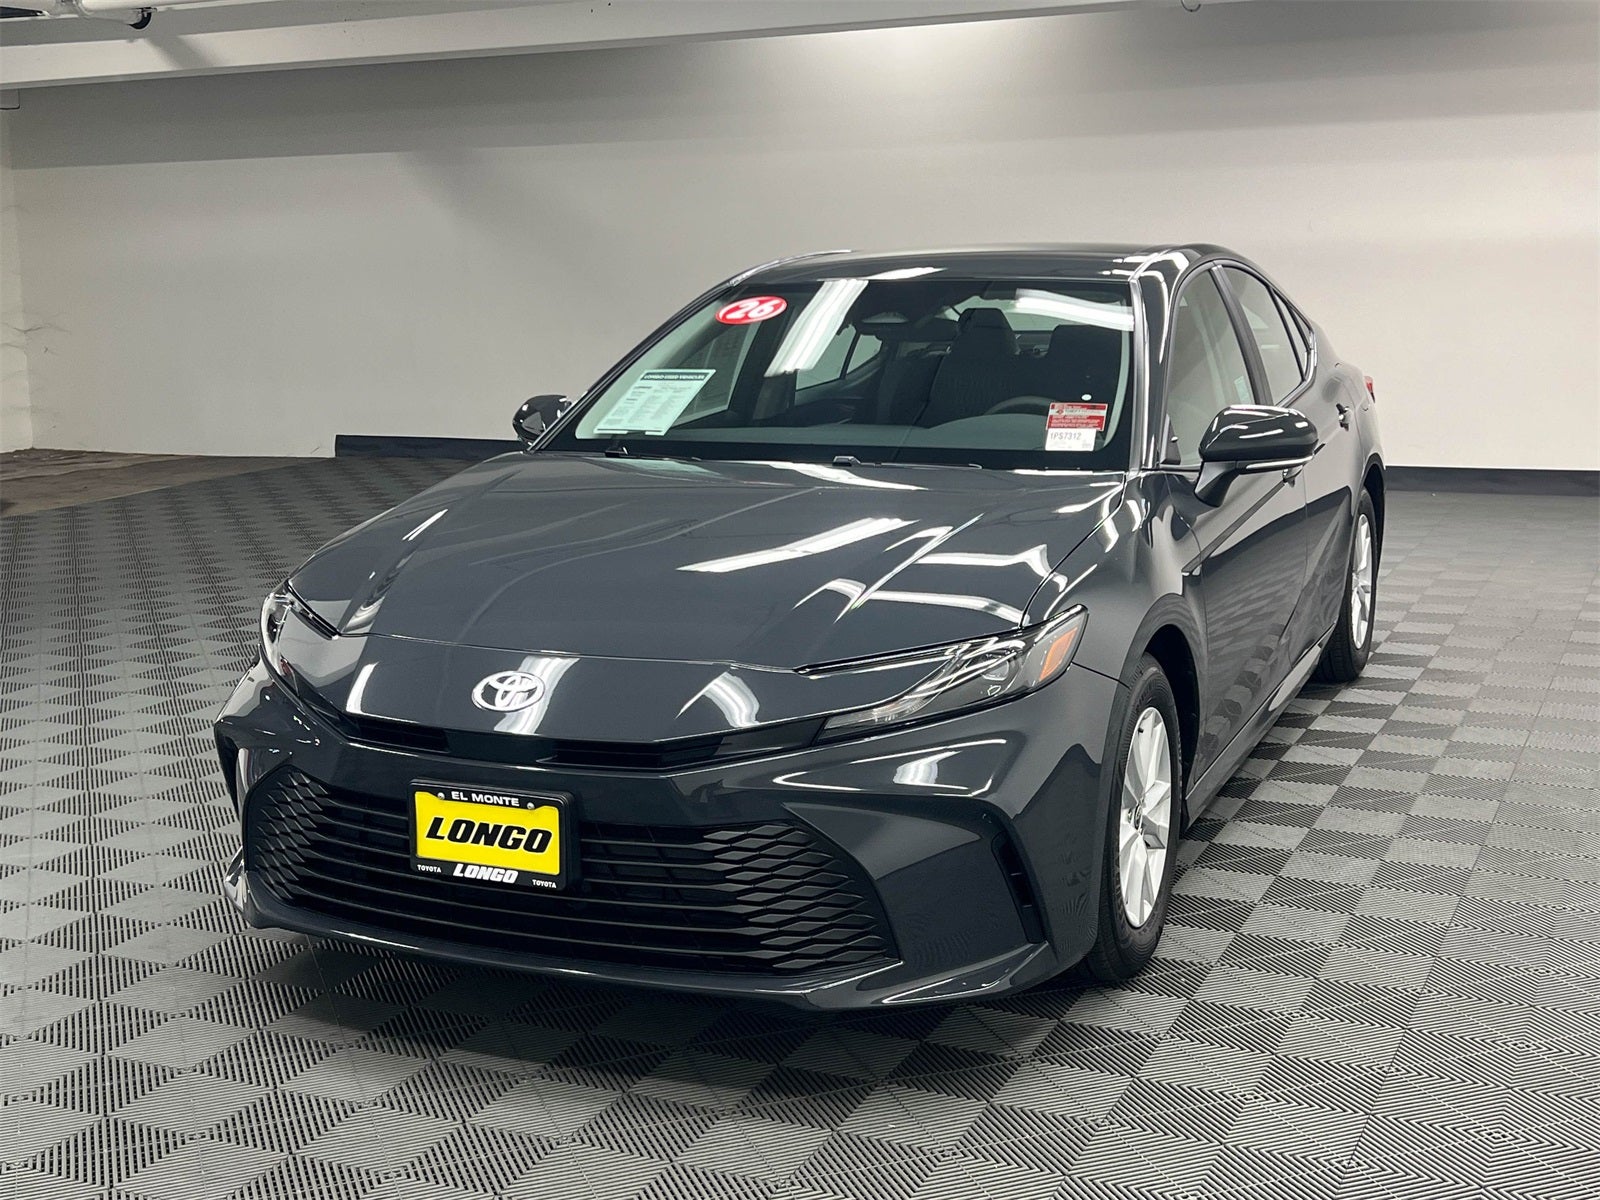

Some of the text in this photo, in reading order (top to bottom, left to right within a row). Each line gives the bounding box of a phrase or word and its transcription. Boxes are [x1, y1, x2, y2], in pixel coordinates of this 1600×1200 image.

[725, 299, 780, 319] 26
[451, 791, 520, 807] EL MONTE
[426, 817, 553, 853] LONGO
[417, 864, 442, 873] TOYOTA
[453, 863, 519, 884] LONGO
[532, 879, 557, 889] TOYOTA
